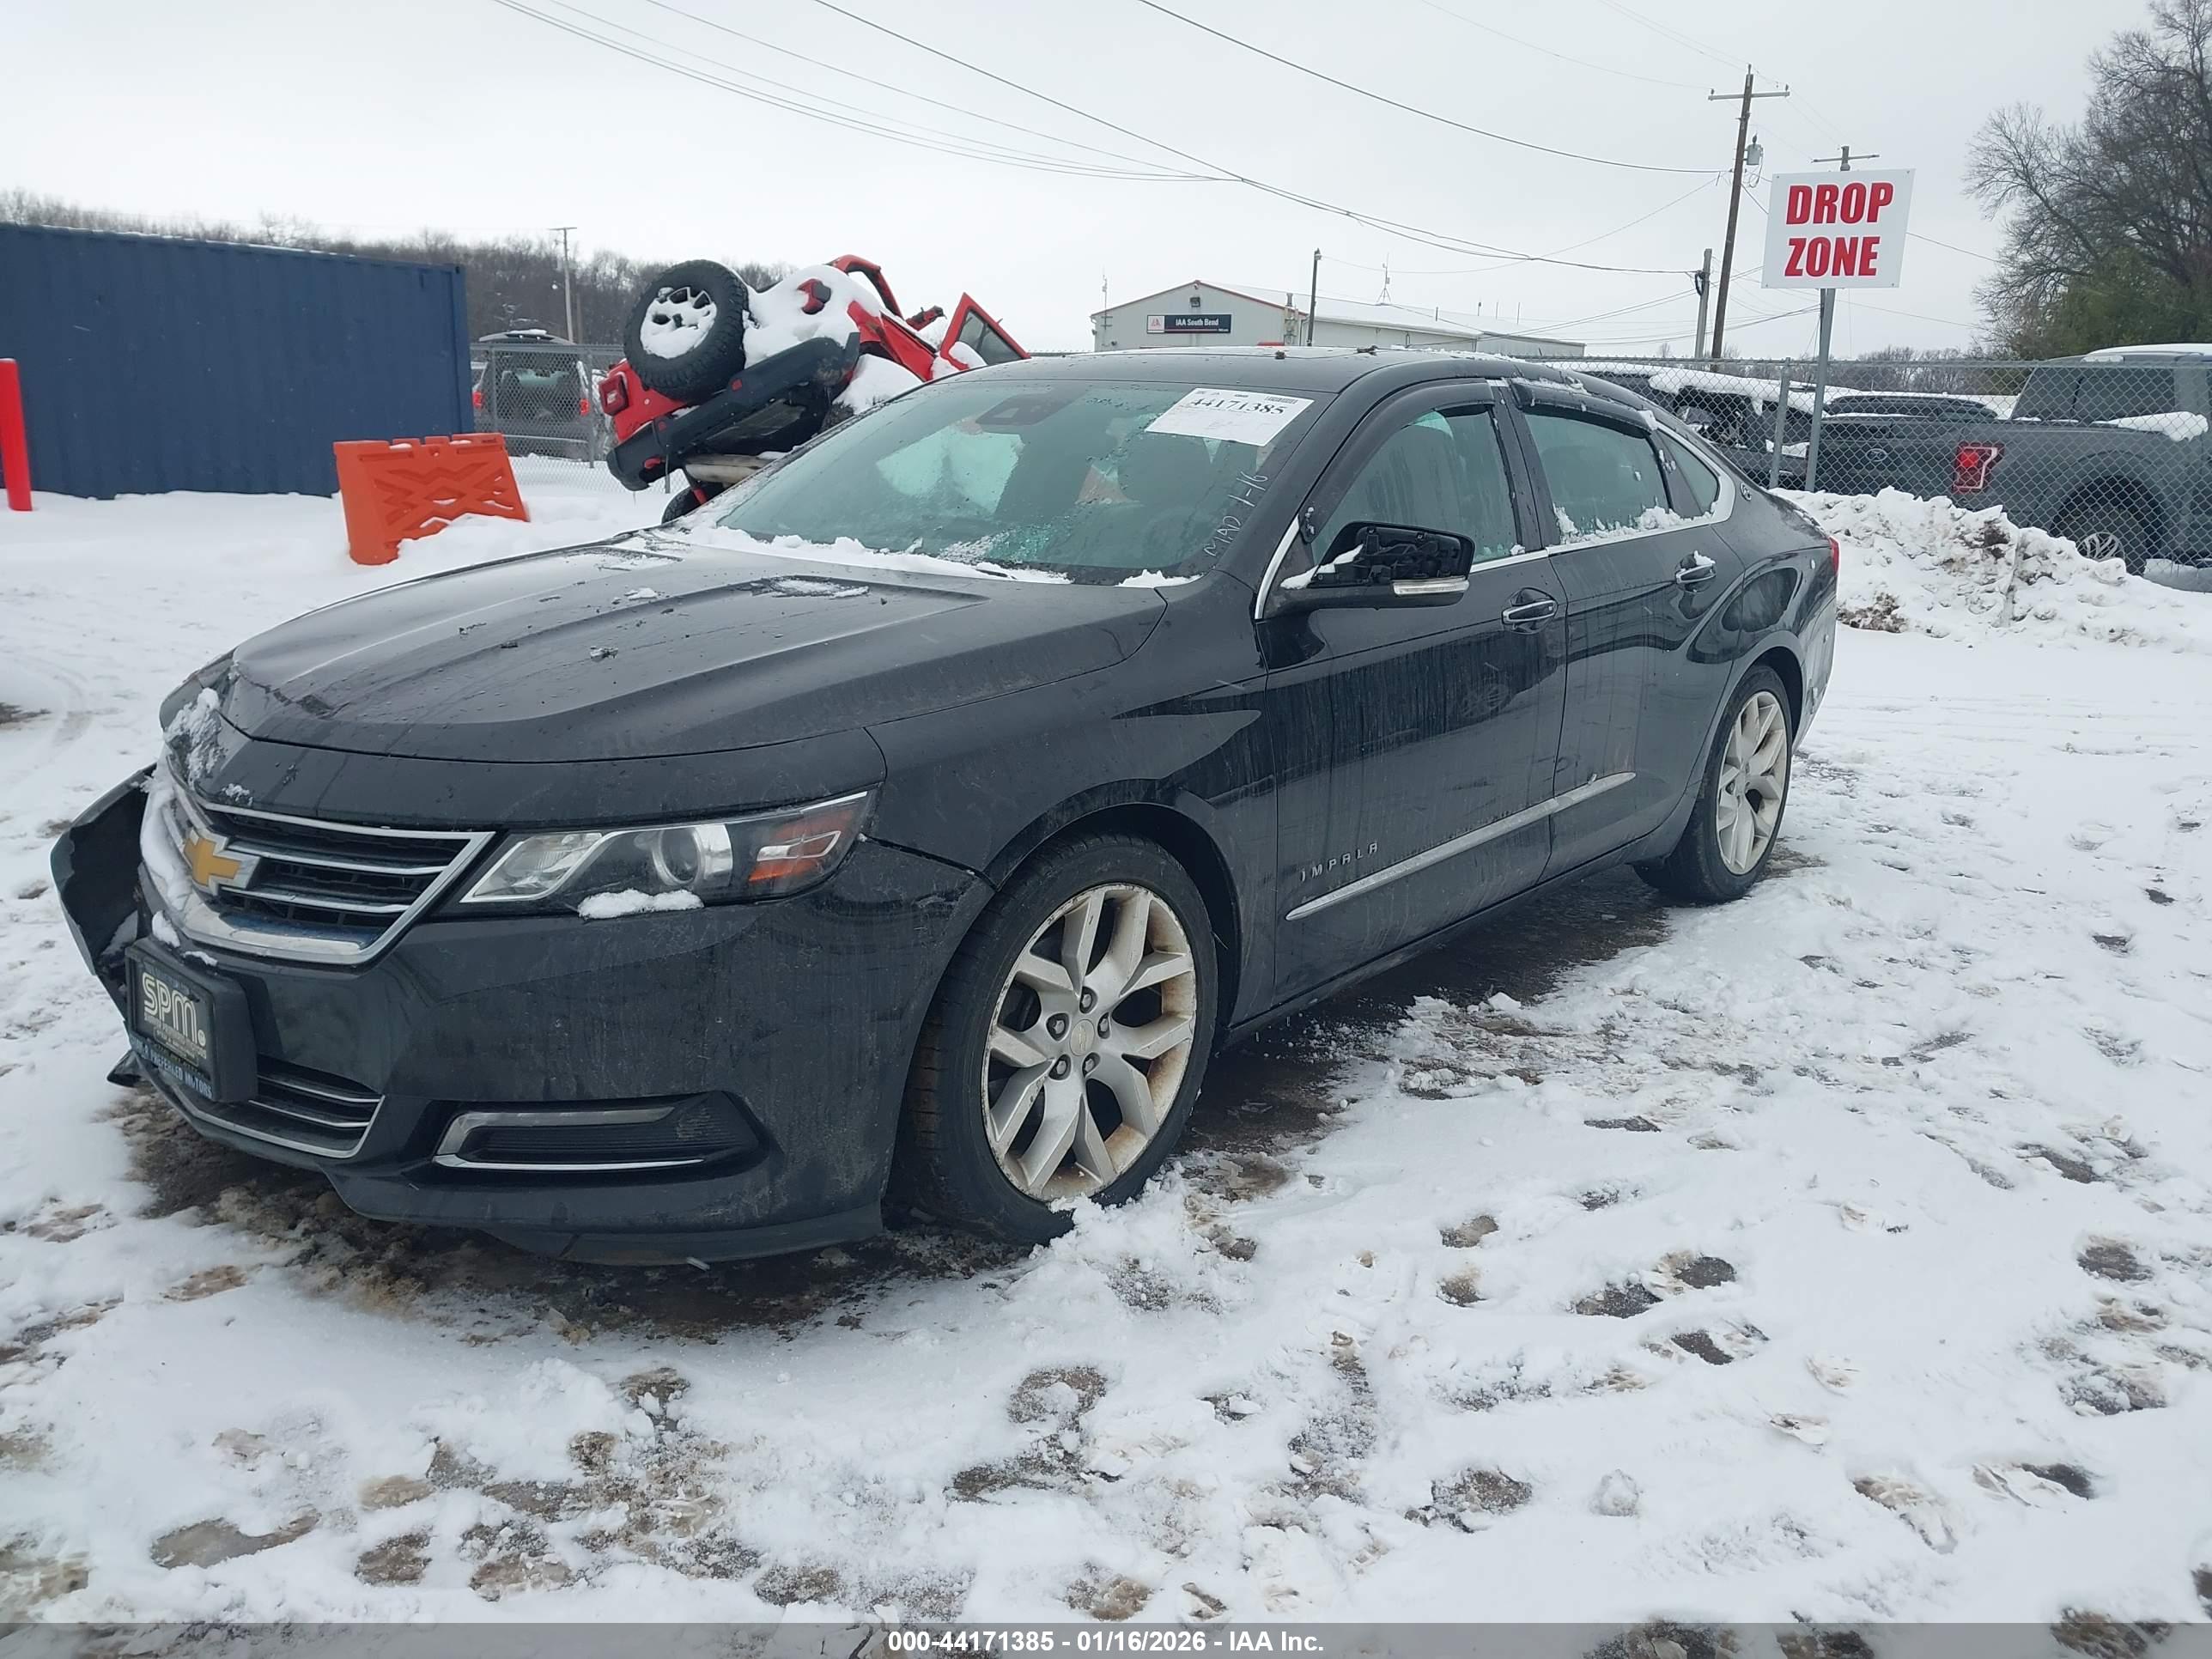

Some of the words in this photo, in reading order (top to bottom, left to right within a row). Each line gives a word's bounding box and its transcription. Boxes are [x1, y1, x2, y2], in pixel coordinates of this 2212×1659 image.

[1785, 181, 1894, 225] DROP
[1784, 235, 1881, 277] ZONE
[1175, 318, 1187, 326] IAA
[1187, 318, 1204, 326] South
[1204, 318, 1219, 326] Bend
[1190, 398, 1288, 415] 44171385
[1226, 470, 1269, 508] 1-16
[1301, 842, 1378, 883] IMPALA
[185, 1071, 214, 1100] MOTORS
